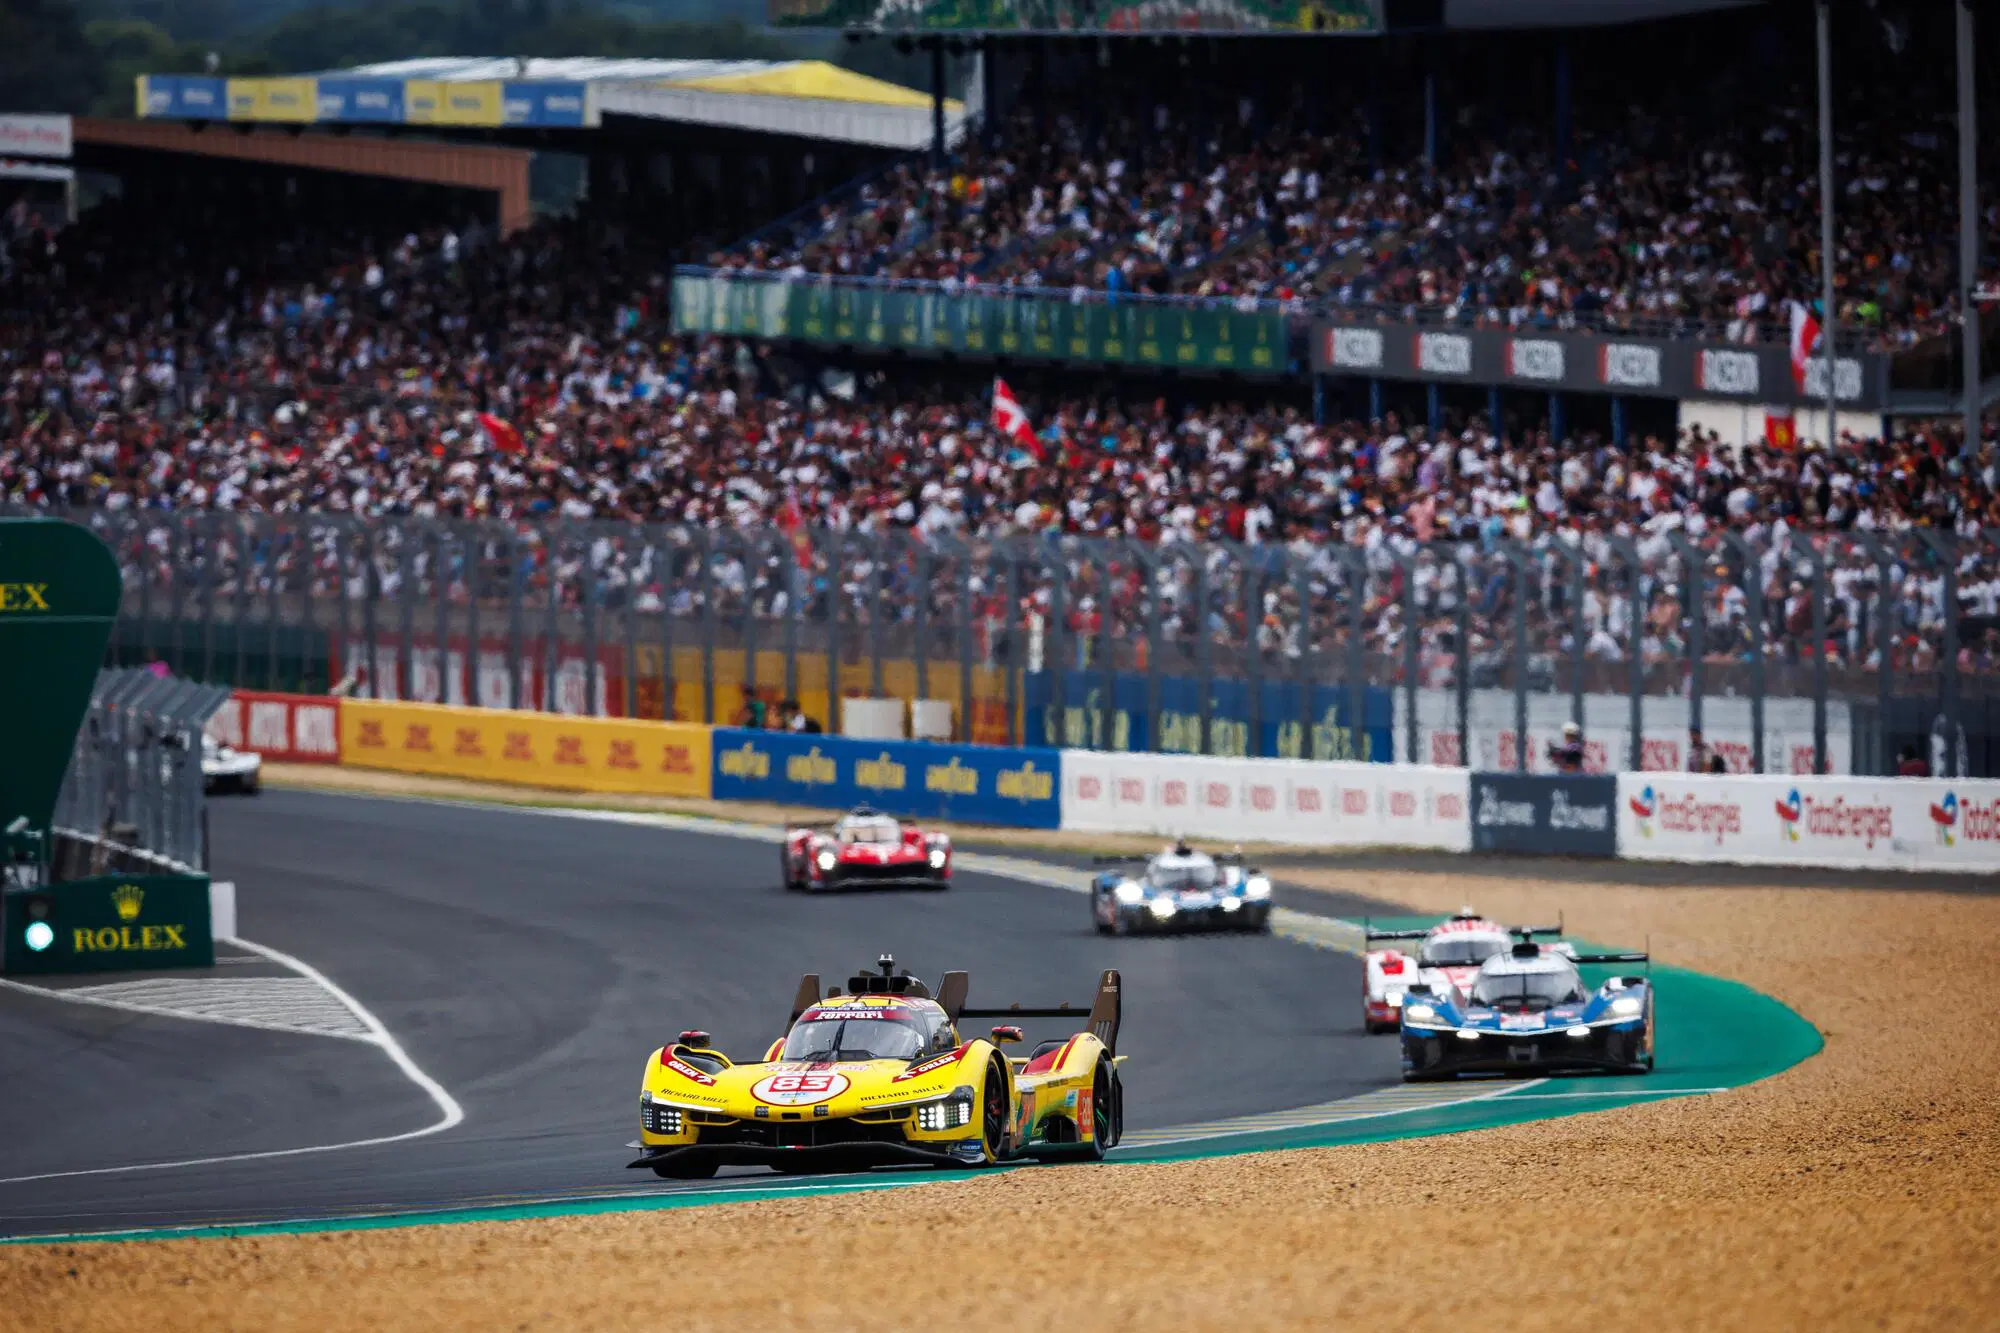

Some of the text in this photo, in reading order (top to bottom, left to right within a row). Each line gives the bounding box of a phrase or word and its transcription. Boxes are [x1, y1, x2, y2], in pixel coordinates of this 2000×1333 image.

[0, 583, 49, 610] EX
[1803, 796, 1893, 849] TotalEnergies
[73, 924, 186, 952] ROLEX
[815, 1010, 884, 1020] Ferrari
[668, 1060, 698, 1077] ORLEN
[918, 1055, 956, 1072] ORLEN
[772, 1077, 829, 1091] 83
[660, 1088, 729, 1104] RICHARD MILLE
[860, 1084, 945, 1102] RICHARD MILLE
